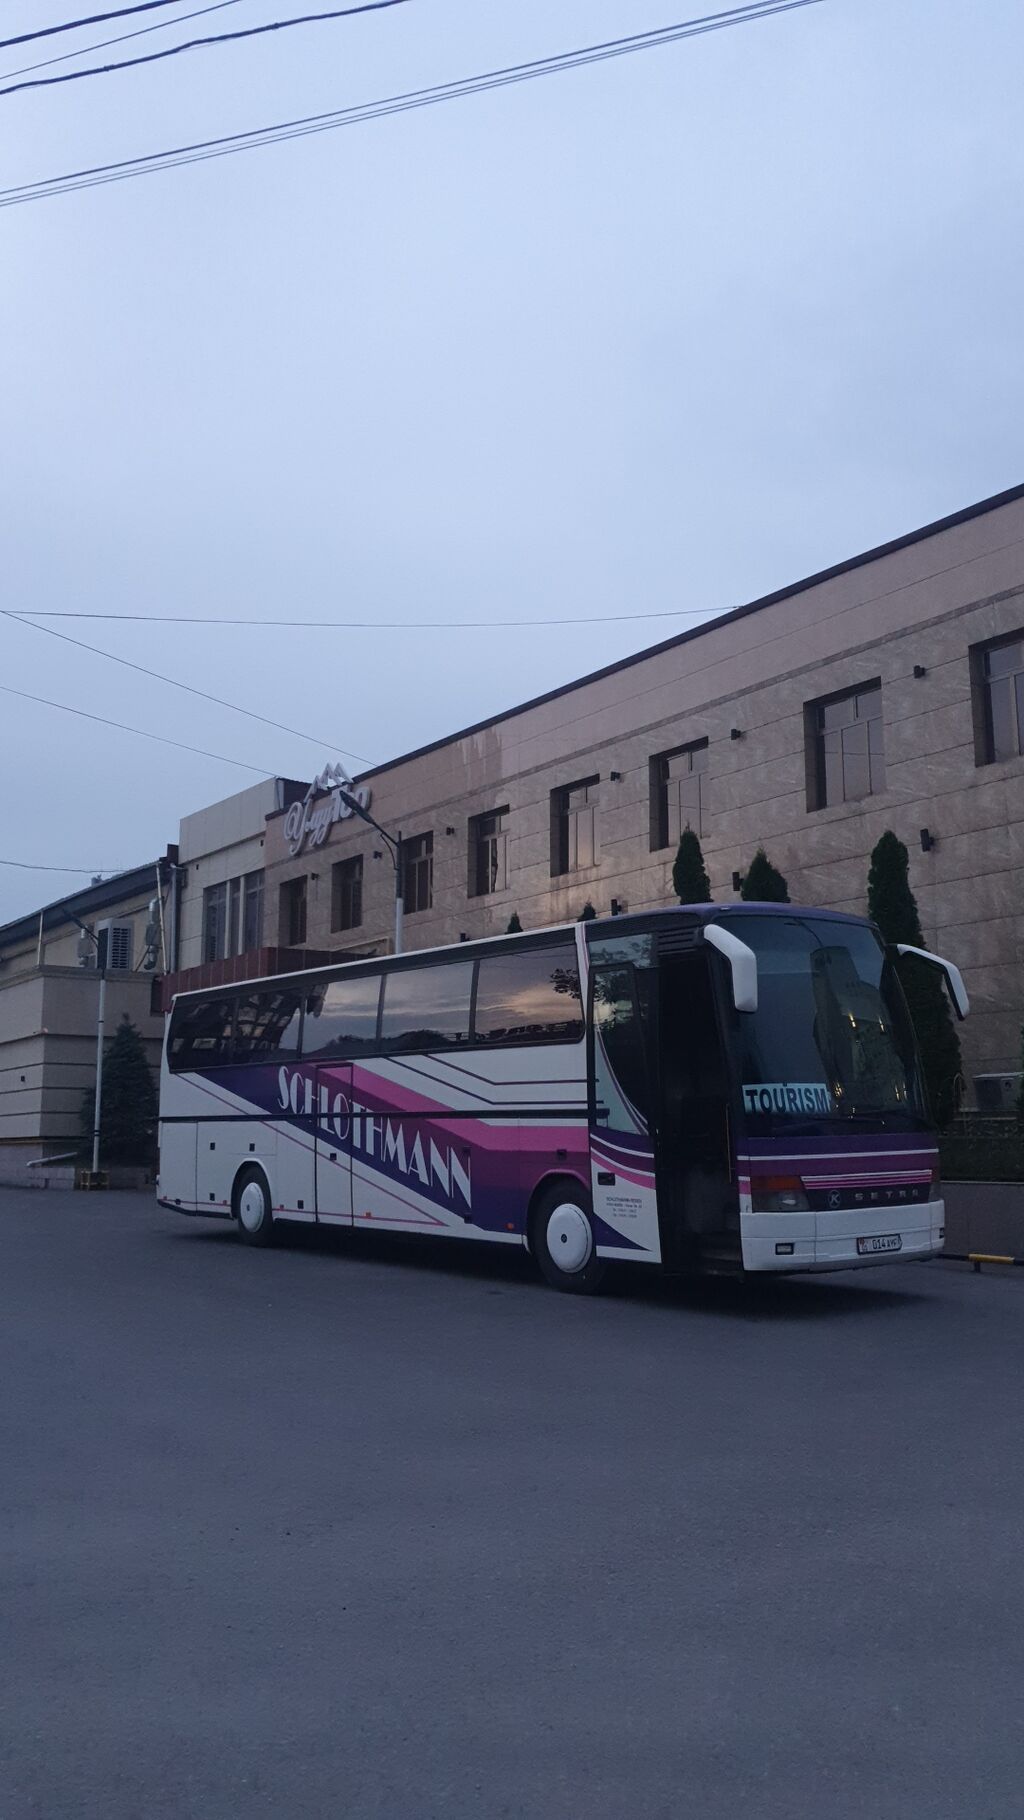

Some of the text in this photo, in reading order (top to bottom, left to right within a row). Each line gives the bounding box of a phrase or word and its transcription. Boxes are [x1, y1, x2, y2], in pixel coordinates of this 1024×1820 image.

[745, 1087, 830, 1113] TOURISM
[278, 1065, 472, 1208] SCHLOTHMANN
[855, 1189, 919, 1201] SETRA
